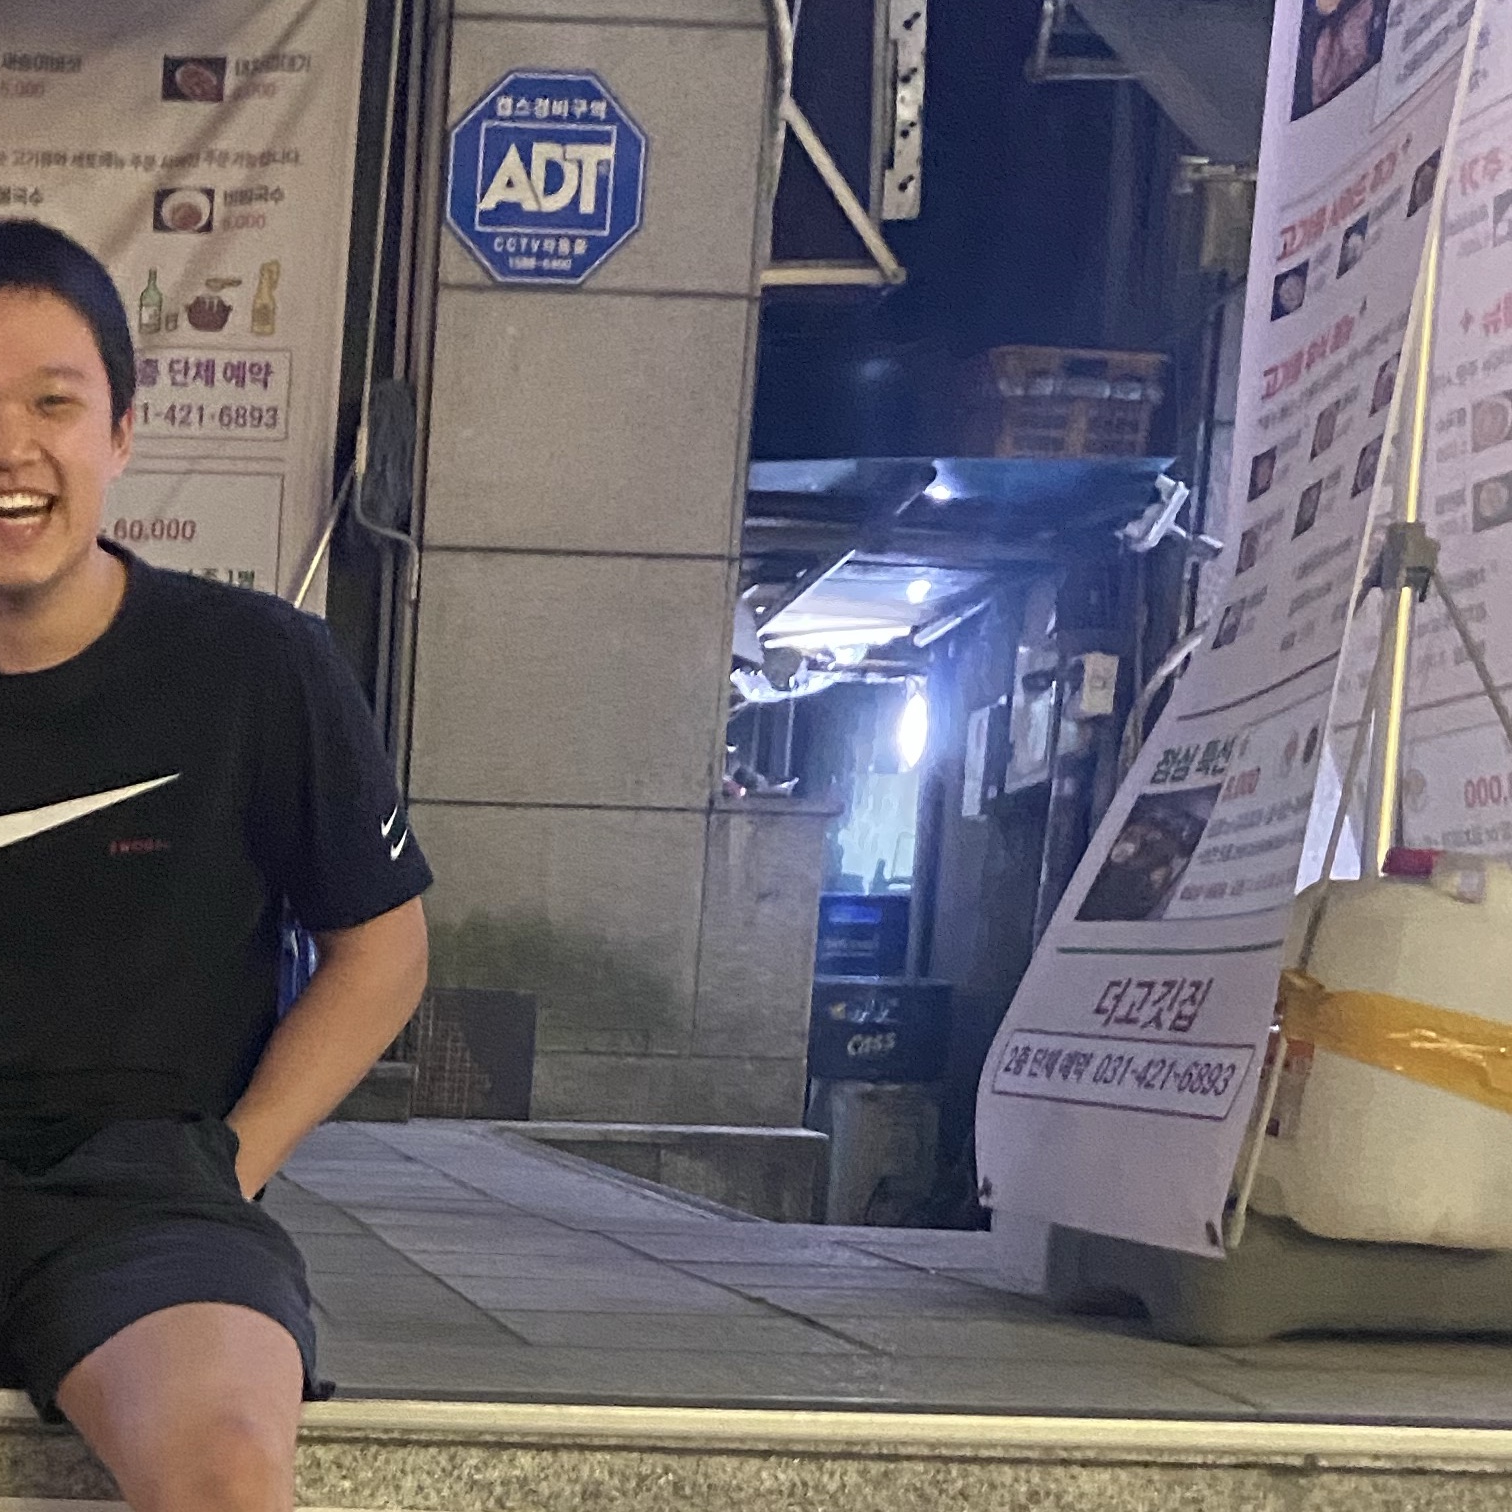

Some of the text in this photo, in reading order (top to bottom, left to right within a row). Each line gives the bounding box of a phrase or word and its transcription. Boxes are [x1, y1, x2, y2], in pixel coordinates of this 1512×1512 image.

[477, 142, 615, 214] ADT
[169, 357, 216, 388] 단체
[223, 360, 273, 391] 예약
[114, 518, 196, 542] 60,000
[1093, 977, 1214, 1032] 더고깃집
[1093, 1054, 1236, 1096] 031-421-6893
